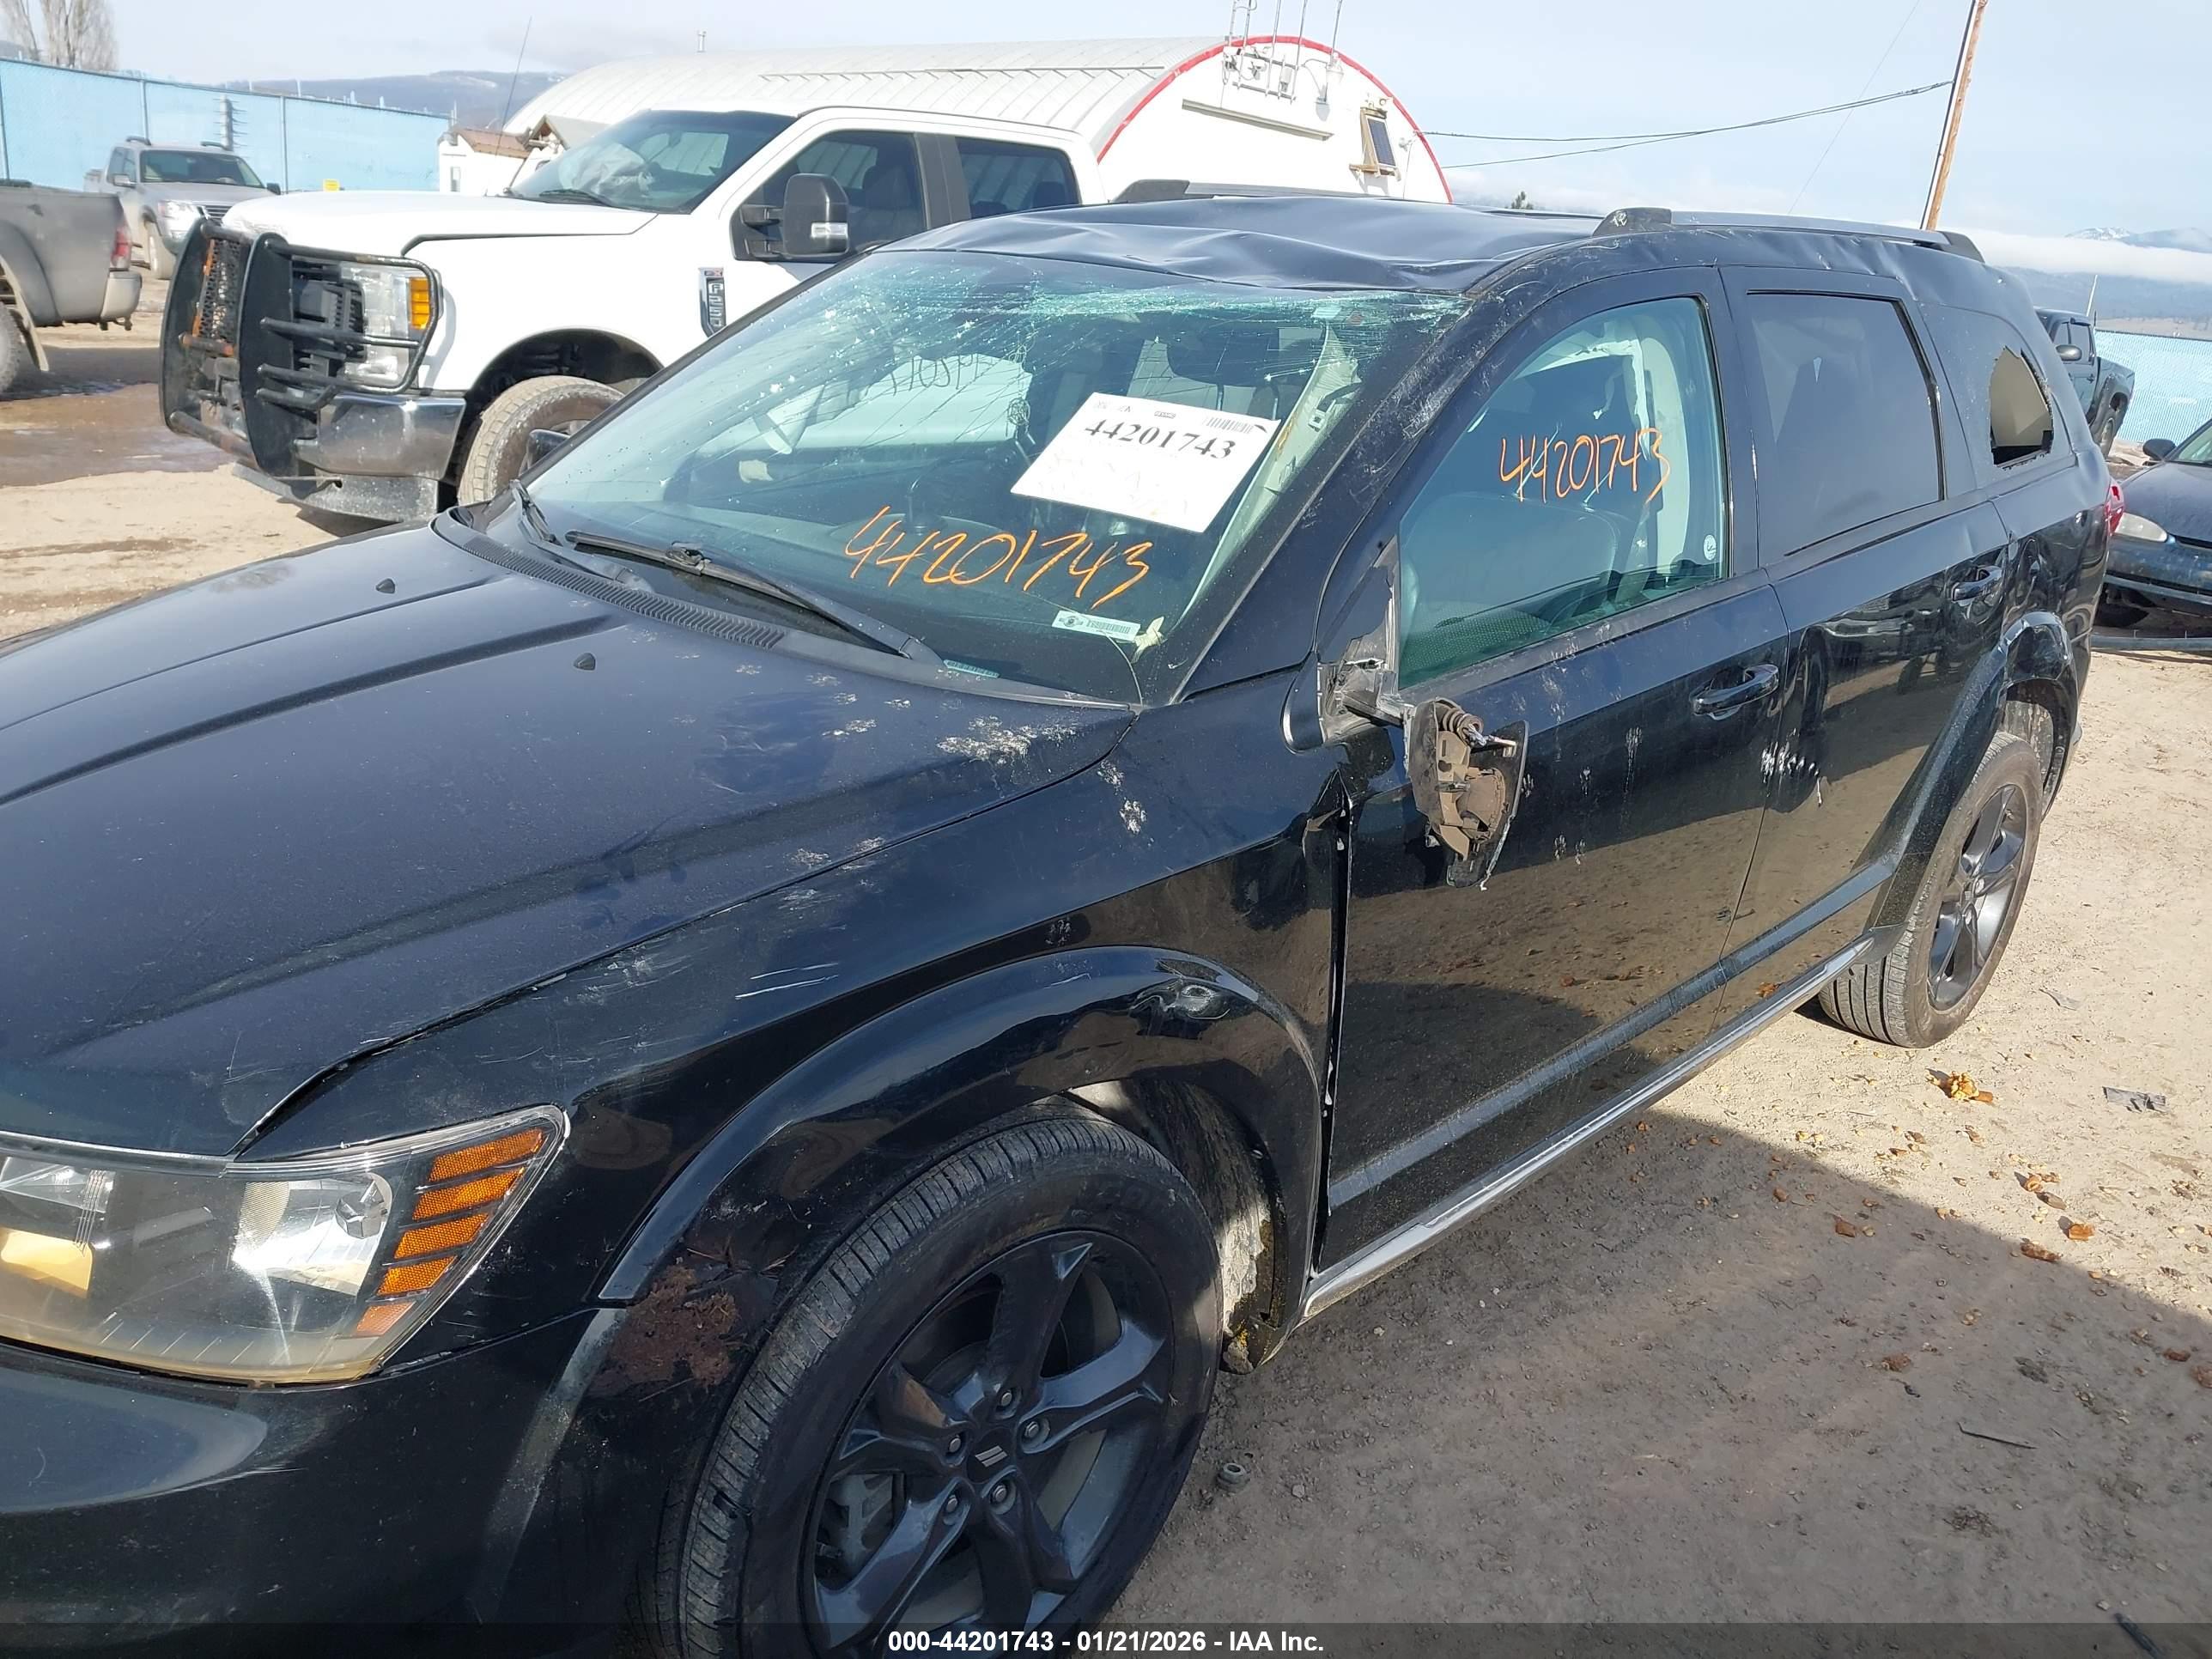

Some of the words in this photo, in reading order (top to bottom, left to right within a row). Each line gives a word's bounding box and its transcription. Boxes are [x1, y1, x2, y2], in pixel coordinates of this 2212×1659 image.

[1085, 419, 1236, 459] 44201743
[1499, 427, 1671, 505] 44201743
[844, 505, 1153, 610] 44201743
